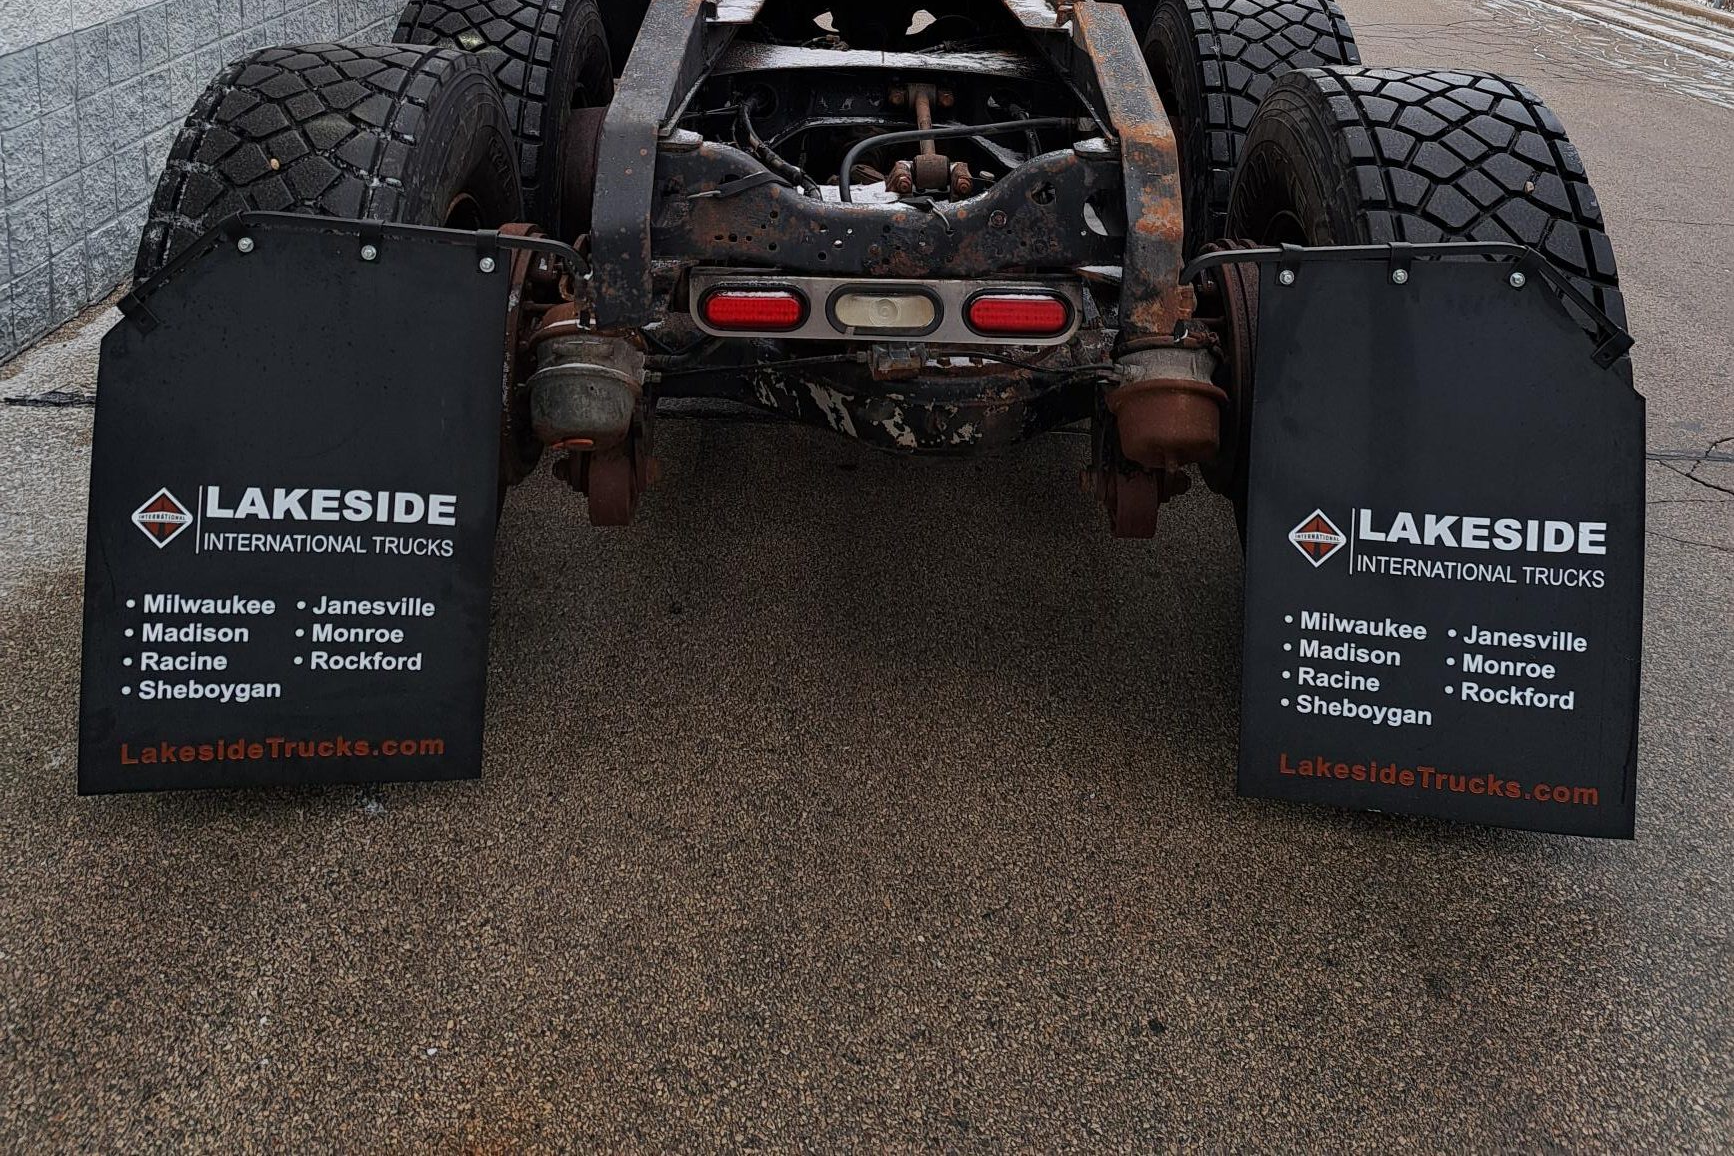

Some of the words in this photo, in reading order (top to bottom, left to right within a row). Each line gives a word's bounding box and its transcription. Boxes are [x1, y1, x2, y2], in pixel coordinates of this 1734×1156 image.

[138, 513, 186, 521] INTERNATIONAL
[206, 486, 457, 526] LAKESIDE
[1294, 533, 1340, 542] INTERNATIONAL
[1359, 509, 1607, 555] LAKESIDE
[204, 533, 366, 554] INTERNATIONAL
[373, 537, 454, 557] TRUCKS
[1357, 555, 1516, 583] INTERNATIONAL
[1523, 567, 1605, 588] TRUCKS
[144, 594, 276, 615] Milwaukee
[313, 596, 436, 617] Janesville
[142, 623, 249, 642] Madison
[312, 624, 404, 643] Monroe
[1301, 611, 1427, 640] Milwaukee
[1464, 626, 1587, 652] Janesville
[141, 652, 228, 671] Racine
[311, 651, 422, 670] Rockford
[1300, 640, 1401, 666] Madison
[1462, 654, 1556, 679] Monroe
[139, 680, 281, 702] Sheboygan
[1298, 667, 1380, 692] Racine
[1461, 682, 1574, 710] Rockford
[1297, 695, 1432, 726] Sheboygan
[121, 737, 445, 765] LakesideTrucks.com
[1279, 753, 1599, 805] LakesideTrucks.com
